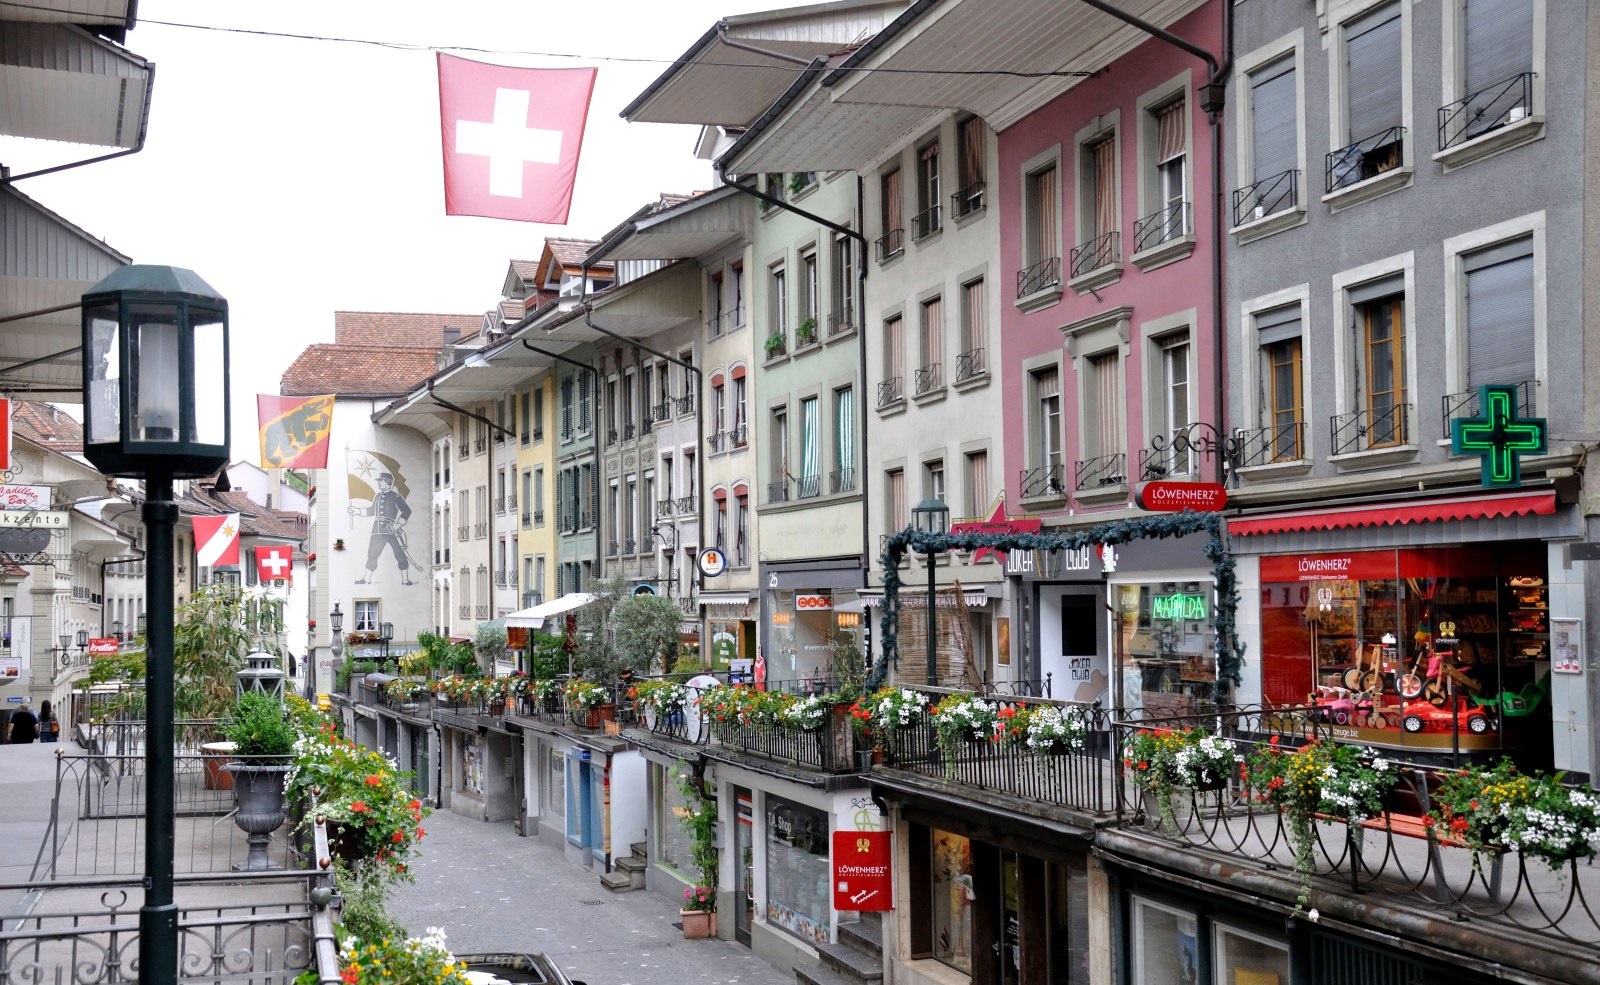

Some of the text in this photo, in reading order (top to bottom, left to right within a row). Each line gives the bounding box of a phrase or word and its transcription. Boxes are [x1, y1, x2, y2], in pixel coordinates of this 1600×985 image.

[8, 495, 27, 504] Bar
[769, 572, 778, 588] 25
[778, 816, 792, 835] Shop
